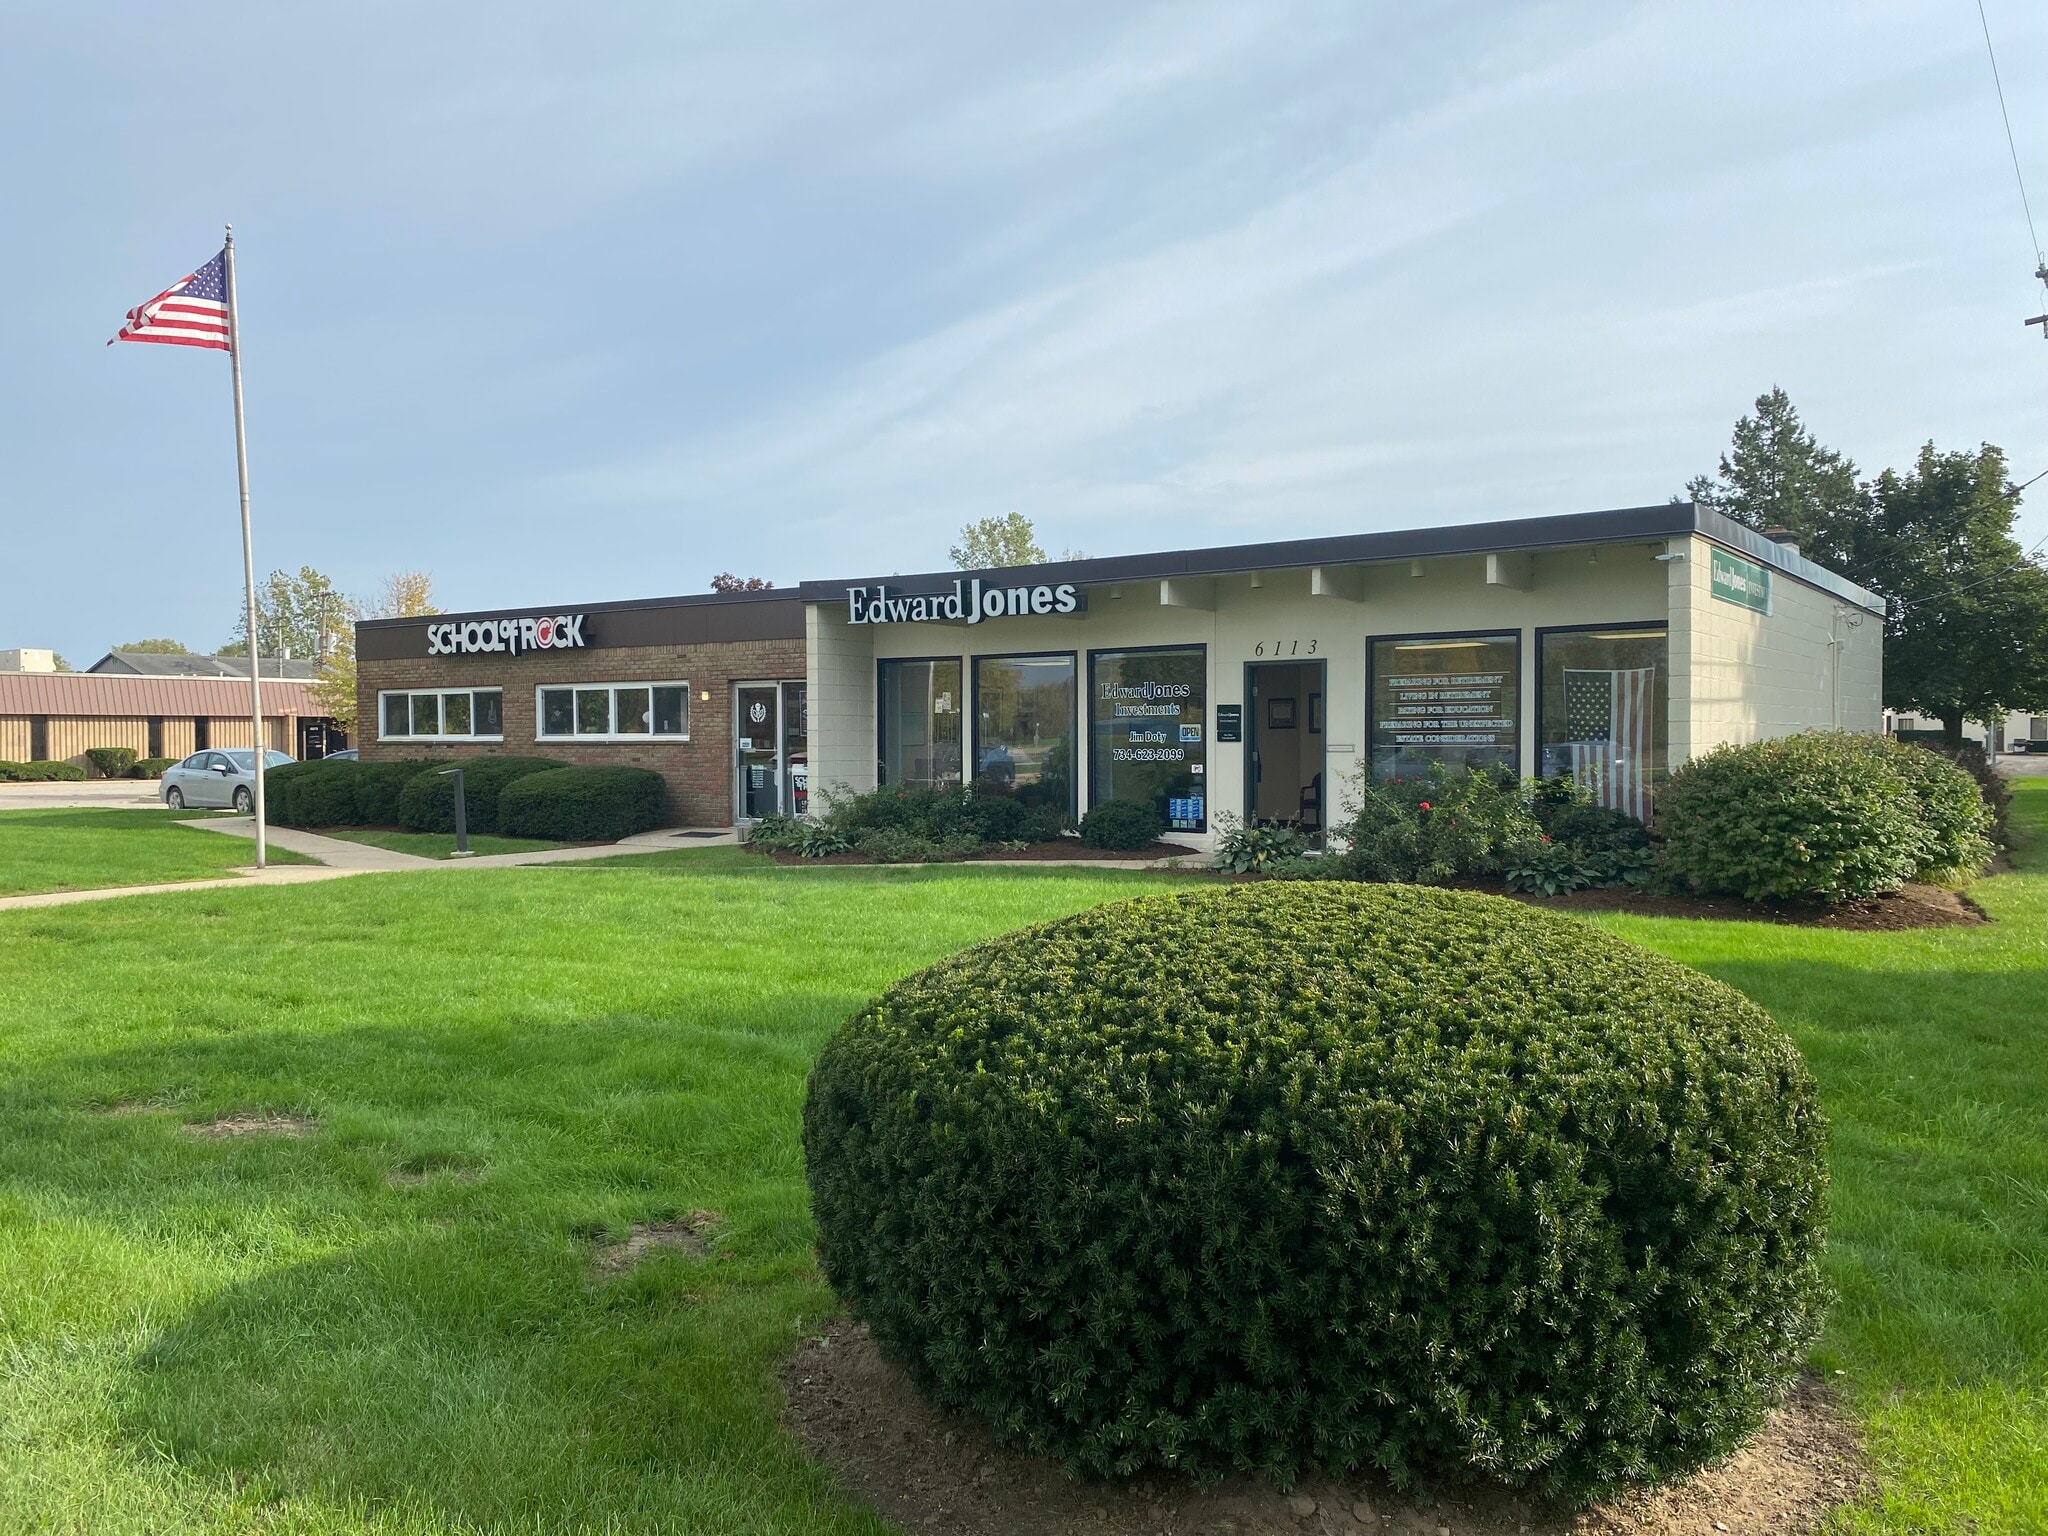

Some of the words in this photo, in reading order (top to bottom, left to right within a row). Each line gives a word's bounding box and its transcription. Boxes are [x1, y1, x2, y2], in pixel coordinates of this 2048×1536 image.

[1255, 639, 1318, 657] 6113
[1388, 678, 1432, 687] PREPARING
[1432, 677, 1450, 685] FOR
[1450, 675, 1503, 685] RETIREMENT
[1400, 692, 1427, 700] LIVING
[1428, 691, 1438, 700] IN
[1439, 690, 1491, 699] RETIREMENT
[1115, 703, 1180, 716] Investments
[1426, 706, 1443, 714] FOR
[1444, 705, 1494, 713] EDUCATION
[1379, 721, 1422, 729] PREPARING
[1422, 720, 1440, 728] FOR
[1440, 720, 1458, 728] THE
[1459, 719, 1514, 728] UNEXPECTED
[1129, 731, 1145, 742] Jim
[1144, 731, 1167, 743] Doty
[1181, 727, 1200, 737] OPEN
[1395, 735, 1424, 743] ESTATE
[1424, 734, 1496, 743] CONSIDERATIONS
[1113, 748, 1184, 761] 734-623-2099
